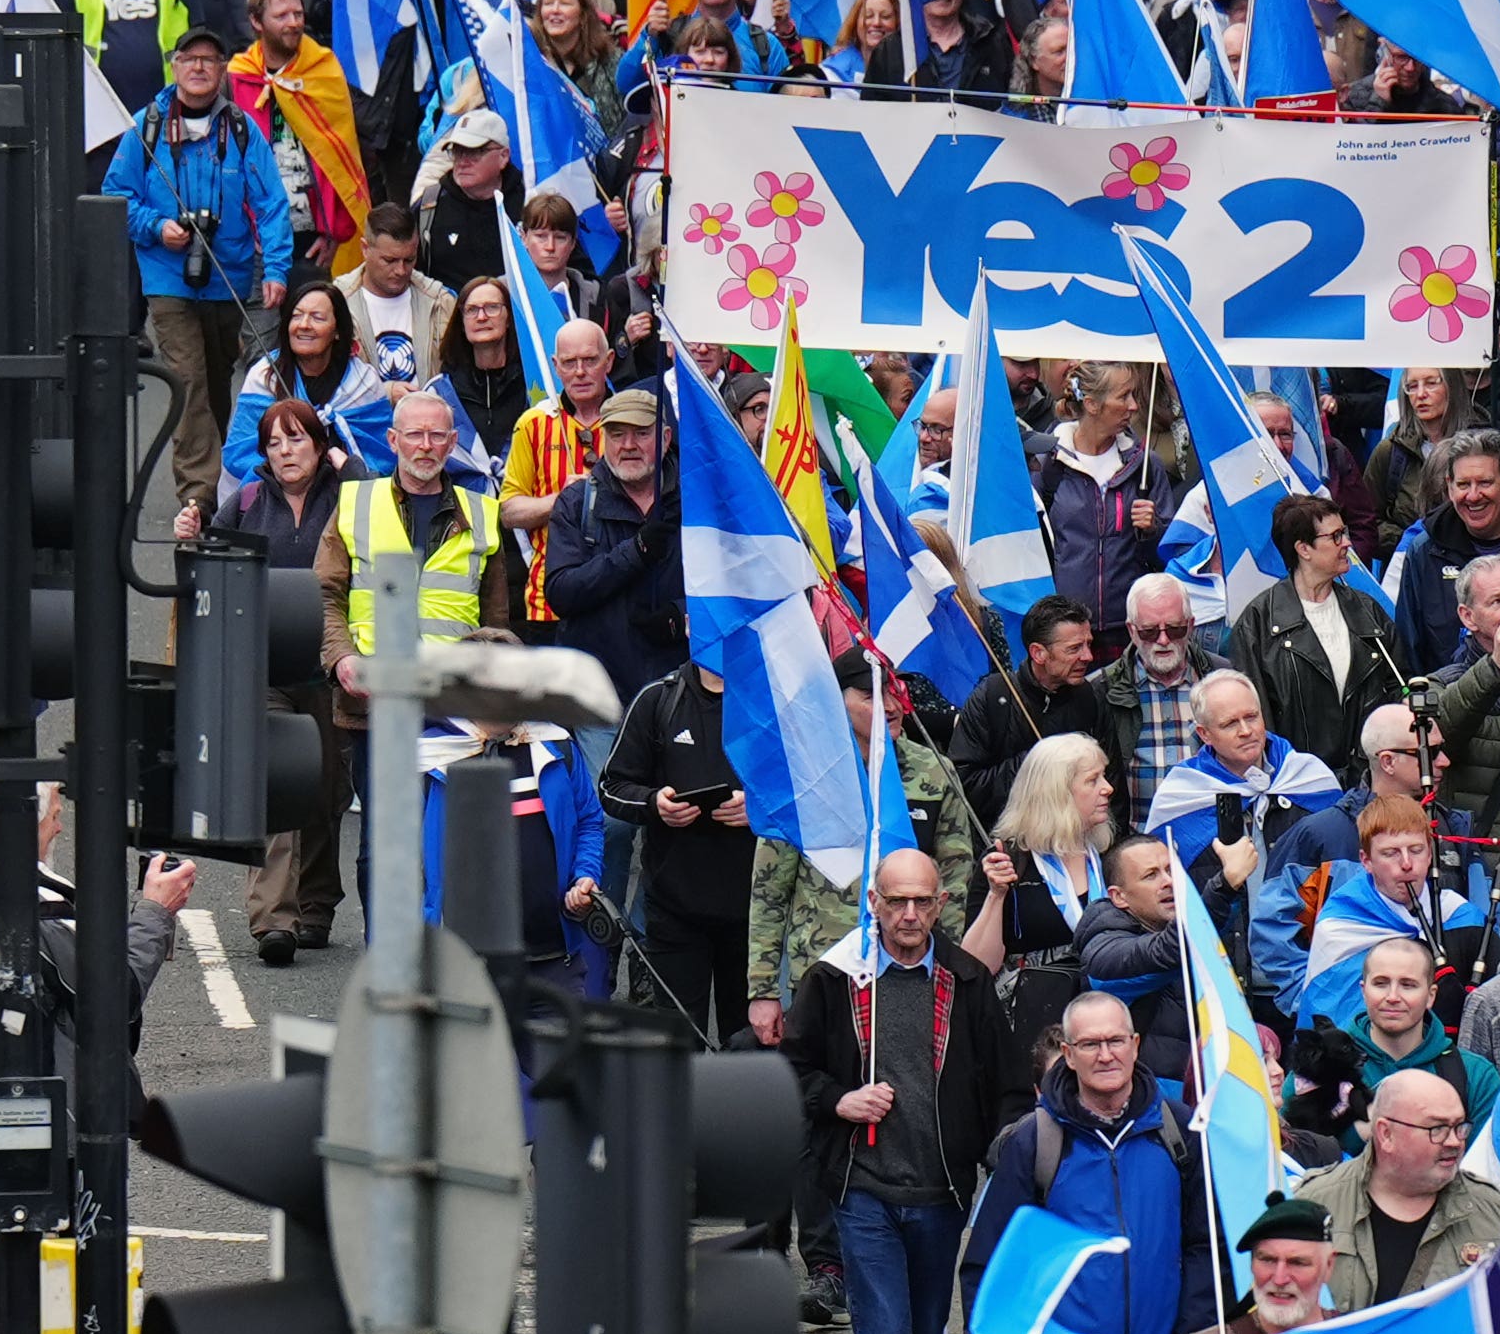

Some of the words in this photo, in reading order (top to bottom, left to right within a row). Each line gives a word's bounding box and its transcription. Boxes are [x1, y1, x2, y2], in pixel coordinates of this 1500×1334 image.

[1336, 139, 1364, 150] John
[1366, 139, 1388, 149] and
[1390, 138, 1417, 149] Jean
[1419, 134, 1471, 146] Crawford
[1336, 151, 1347, 161] in
[1349, 151, 1398, 161] absentia
[793, 126, 1195, 337] Yes
[1218, 177, 1367, 340] 2
[195, 589, 211, 616] 20
